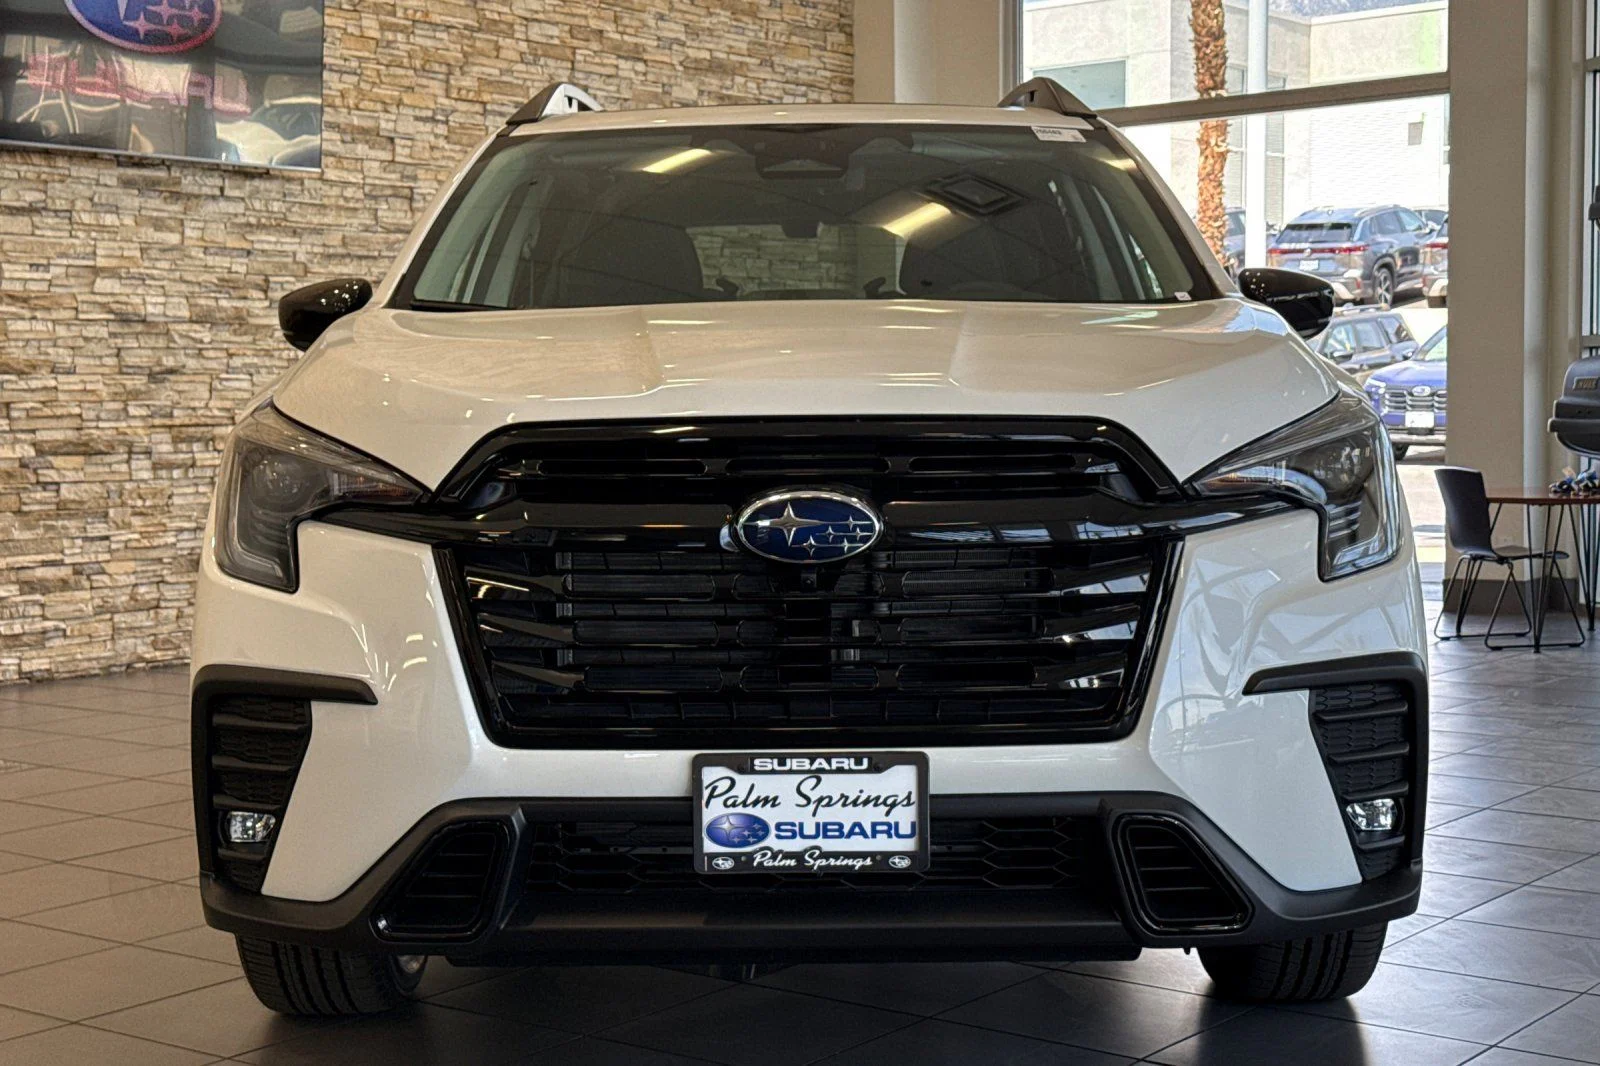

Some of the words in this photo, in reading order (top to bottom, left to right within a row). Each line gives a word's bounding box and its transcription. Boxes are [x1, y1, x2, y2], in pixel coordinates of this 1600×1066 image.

[754, 758, 868, 770] SUBARU
[704, 776, 781, 809] Palm
[795, 775, 916, 817] Springs
[775, 822, 916, 839] SUBARU
[753, 850, 797, 867] Palm
[804, 849, 873, 870] Springs
